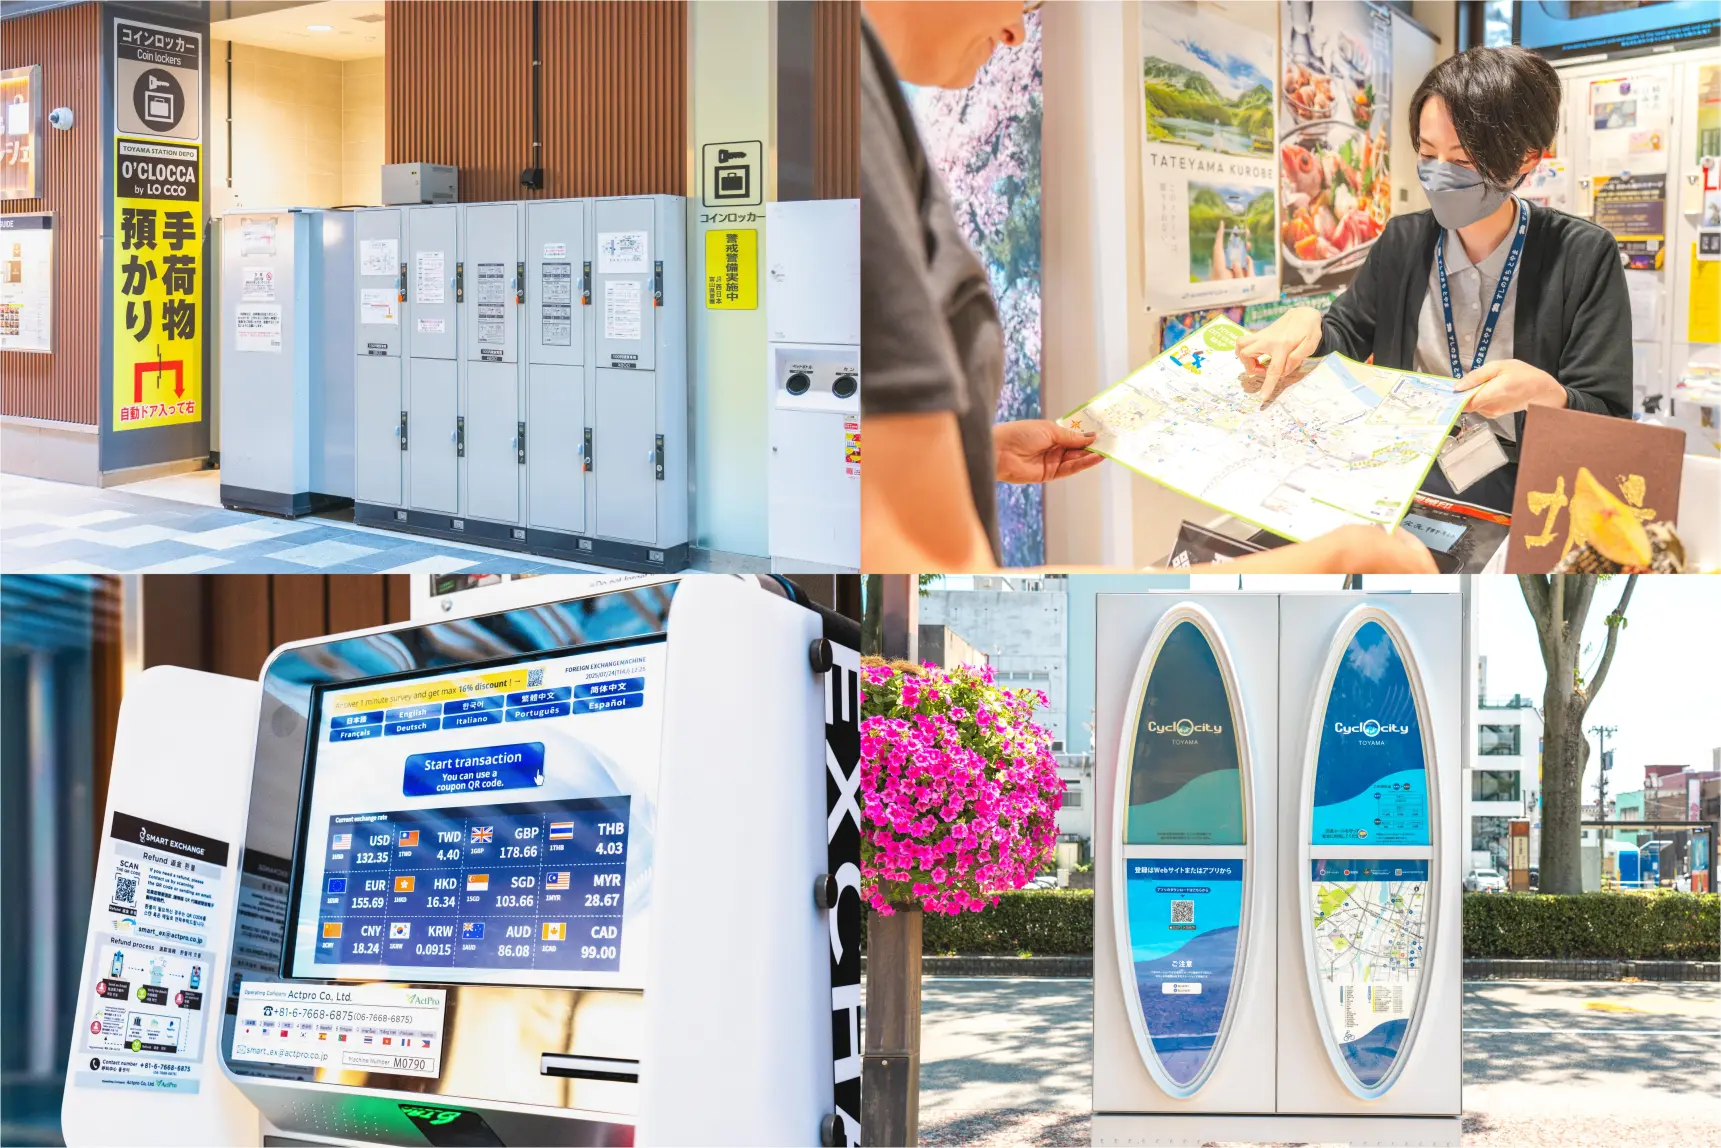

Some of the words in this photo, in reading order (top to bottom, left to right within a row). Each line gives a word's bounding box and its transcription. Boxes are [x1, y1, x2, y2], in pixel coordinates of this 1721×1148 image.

[122, 28, 195, 52] コインロッカー
[137, 49, 154, 61] Coin
[155, 52, 181, 66] lockers
[123, 146, 151, 154] TOYAMA
[151, 148, 178, 156] STATION
[1150, 153, 1225, 174] TATEYAMA
[1229, 164, 1273, 180] KUROBE
[134, 185, 145, 195] by
[147, 183, 162, 195] LO
[163, 185, 187, 197] CCO
[700, 211, 766, 224] コインロッカー
[725, 233, 739, 301] 警戒警備実施中
[120, 207, 158, 343] 預かり
[162, 210, 196, 341] 手荷物
[1495, 269, 1512, 300] すしのまち
[120, 401, 195, 422] 自動ドア入って右
[565, 664, 590, 673] FOREIGN
[335, 700, 359, 709] Answer
[365, 697, 389, 705] minute
[390, 693, 414, 703] survey
[413, 691, 426, 700] and
[428, 689, 440, 700] get
[441, 688, 457, 696] max
[459, 683, 473, 692] 16%
[474, 679, 507, 691] discount
[590, 682, 627, 695] 简体中文
[462, 700, 484, 711] 한국어
[589, 698, 626, 710] Español
[399, 709, 427, 718] English
[515, 707, 560, 719] Português
[456, 716, 488, 725] Italiano
[396, 722, 427, 732] Deutsch
[1148, 718, 1222, 736] Cyclocity
[1334, 719, 1409, 737] Cyclocity
[340, 729, 371, 740] Français
[424, 758, 453, 771] Start
[455, 752, 522, 768] transaction
[442, 773, 458, 782] You
[459, 772, 474, 780] can
[476, 770, 490, 779] use
[436, 783, 466, 793] coupon
[468, 780, 480, 790] QR
[481, 779, 504, 788] code.
[354, 814, 377, 823] exchange
[514, 827, 539, 839] GBP
[598, 822, 625, 835] THB
[369, 834, 390, 847] USD
[437, 831, 462, 843] TWD
[146, 833, 170, 846] SMART
[169, 840, 206, 856] EXCHANGE
[595, 842, 623, 855] 4.03
[436, 849, 460, 860] 4.40
[499, 845, 538, 858] 178.66
[142, 852, 168, 865] Refund
[356, 852, 389, 864] 132.35
[119, 859, 139, 870] SCAN
[1134, 866, 1232, 875] 登録はWebサイトまたはアプリから
[365, 880, 386, 891] EUR
[433, 878, 457, 890] HKD
[511, 876, 535, 888] SGD
[593, 874, 621, 887] MYR
[351, 897, 385, 909] 155.69
[426, 896, 456, 908] 16.34
[495, 895, 534, 907] 103.66
[584, 894, 620, 907] 28.67
[138, 926, 203, 944] smart_ex@actpro.co.jp
[361, 925, 382, 937] CNY
[428, 925, 453, 937] KRW
[506, 926, 532, 938] AUD
[591, 926, 618, 939] CAD
[110, 937, 132, 947] Refund
[132, 942, 155, 951] process
[352, 942, 380, 954] 18.24
[415, 943, 452, 955] 0.0915
[498, 945, 530, 957] 86.08
[580, 946, 617, 959] 99.00
[1171, 960, 1193, 968] ご注意
[244, 989, 266, 997] Operating
[266, 990, 287, 998] Company
[287, 990, 317, 1000] Actpro
[336, 992, 352, 1001] Ltd.
[414, 996, 440, 1006] ActPro
[246, 1047, 328, 1061] smart_ex@actpro.co.jp
[102, 1059, 121, 1067] Contact
[140, 1062, 191, 1072] +81-6-7668-6875
[348, 1056, 369, 1064] Machine
[393, 1057, 426, 1070] M0790
